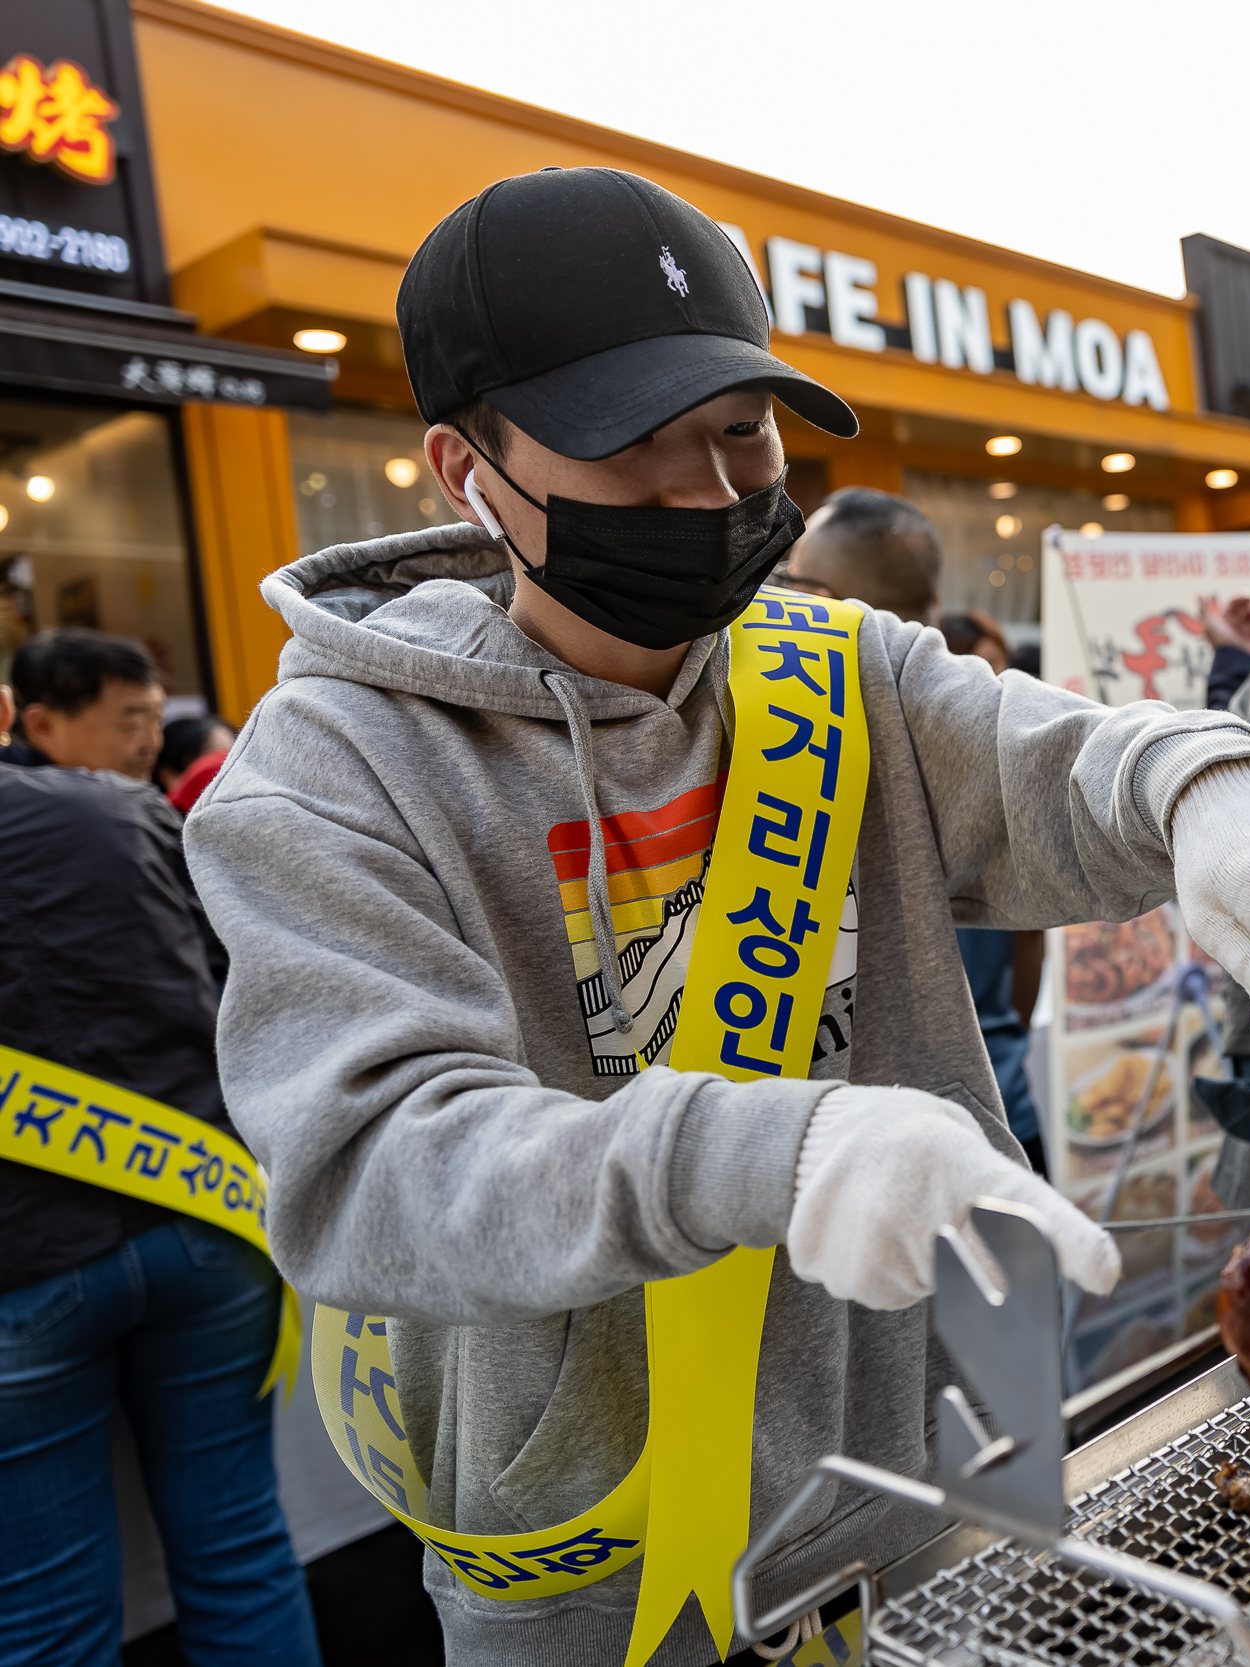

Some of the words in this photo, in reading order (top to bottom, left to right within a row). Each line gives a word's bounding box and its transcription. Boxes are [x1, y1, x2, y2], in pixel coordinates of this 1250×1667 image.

[904, 272, 994, 375] IN
[1008, 297, 1171, 411] MOA
[714, 586, 849, 1077] 꼬치거리상인
[0, 1071, 267, 1231] 치거리상인
[402, 1525, 640, 1589] 인회
